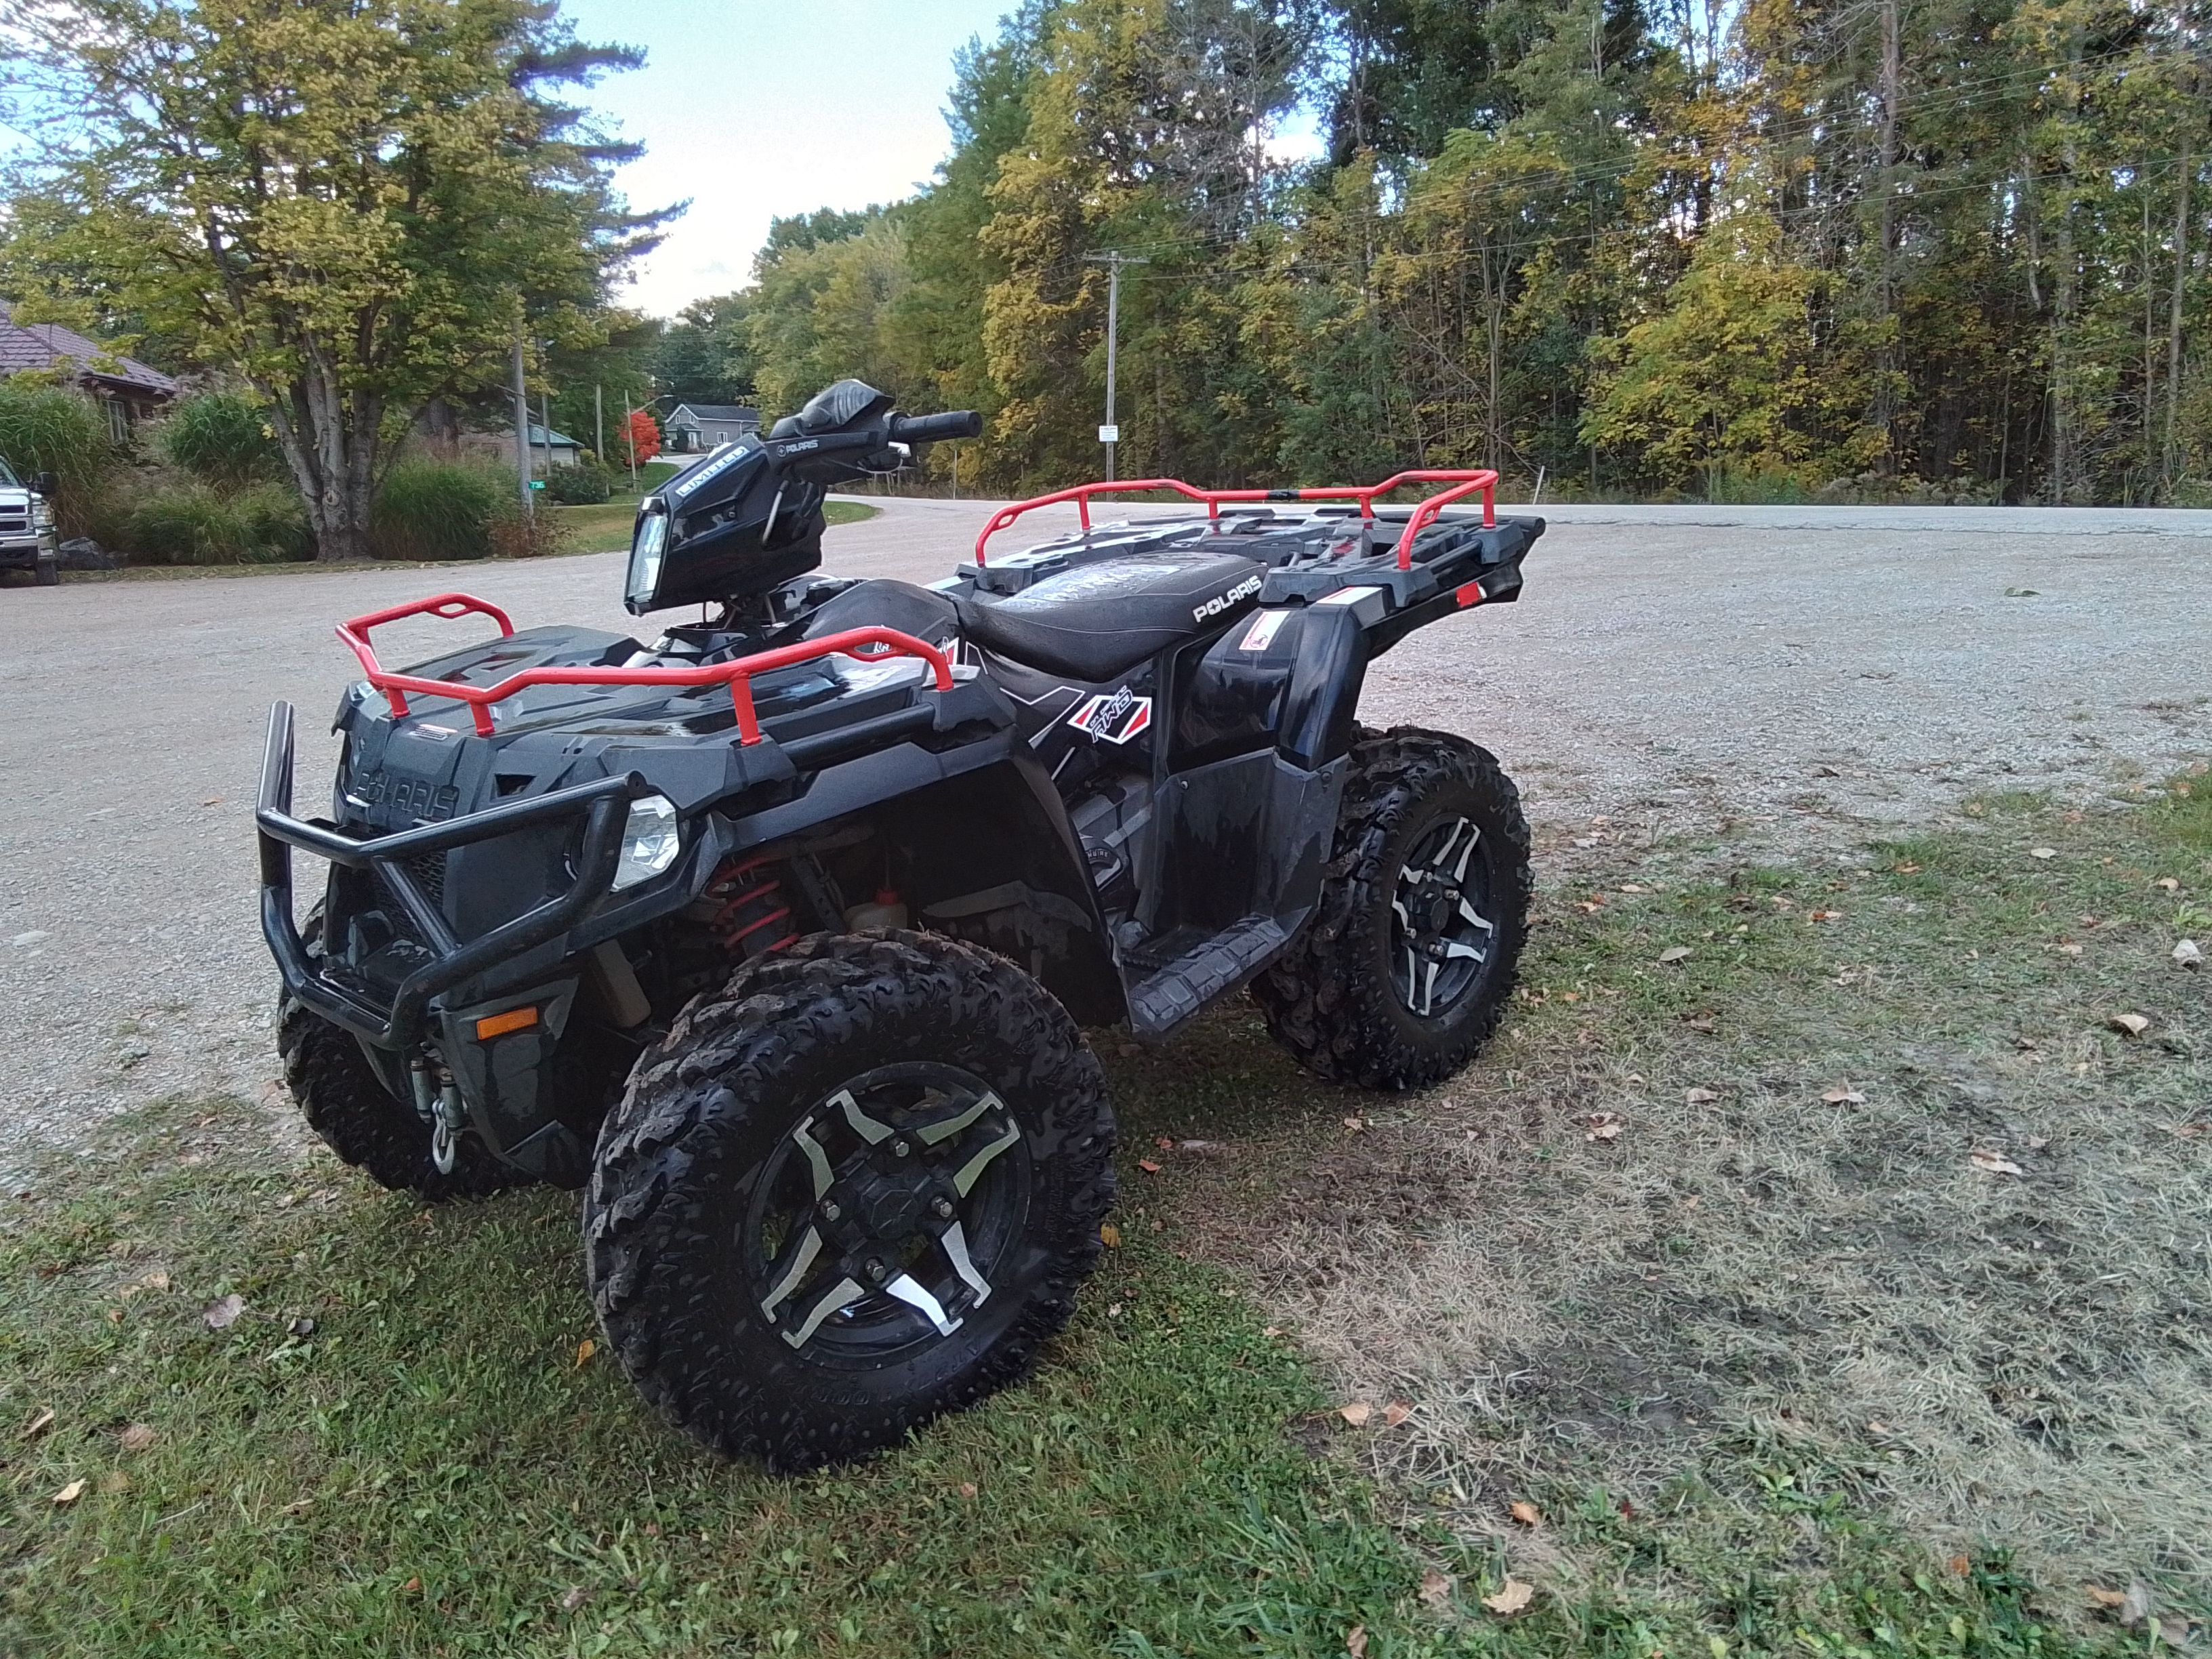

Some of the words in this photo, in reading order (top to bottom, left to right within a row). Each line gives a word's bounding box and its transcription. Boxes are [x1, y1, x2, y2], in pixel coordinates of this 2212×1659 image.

[786, 440, 819, 453] POLARIS
[1193, 575, 1262, 622] POLARIS
[1091, 689, 1132, 743] AWD
[353, 771, 459, 820] POLARIS
